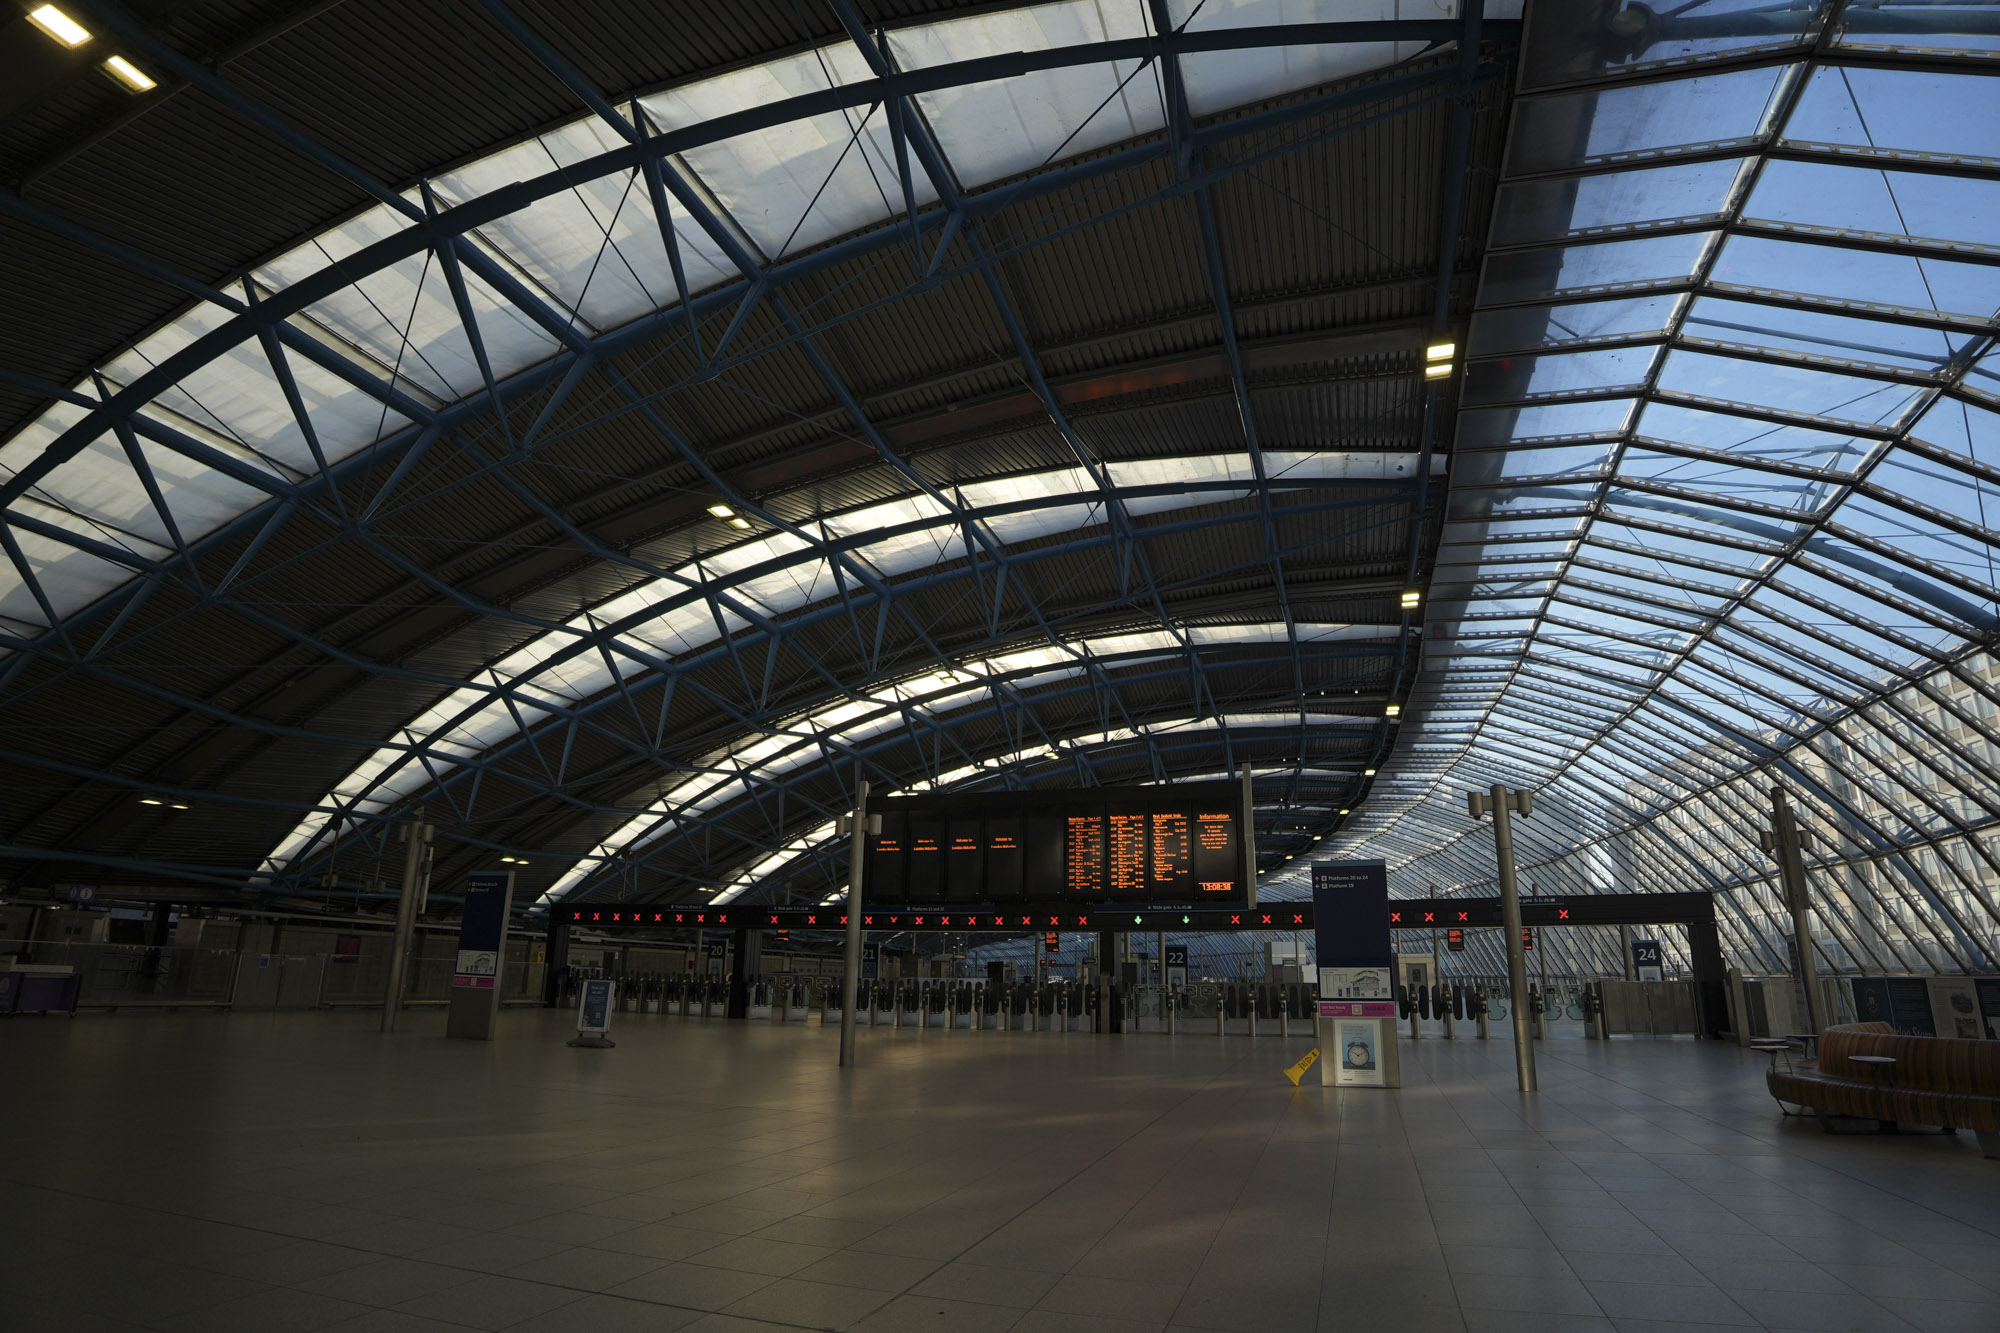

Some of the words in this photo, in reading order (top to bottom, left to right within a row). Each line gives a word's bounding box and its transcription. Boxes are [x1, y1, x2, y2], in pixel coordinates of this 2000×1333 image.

[710, 944, 723, 956] 20
[863, 948, 875, 960] 21
[1637, 948, 1657, 961] 24
[1168, 952, 1184, 963] 22
